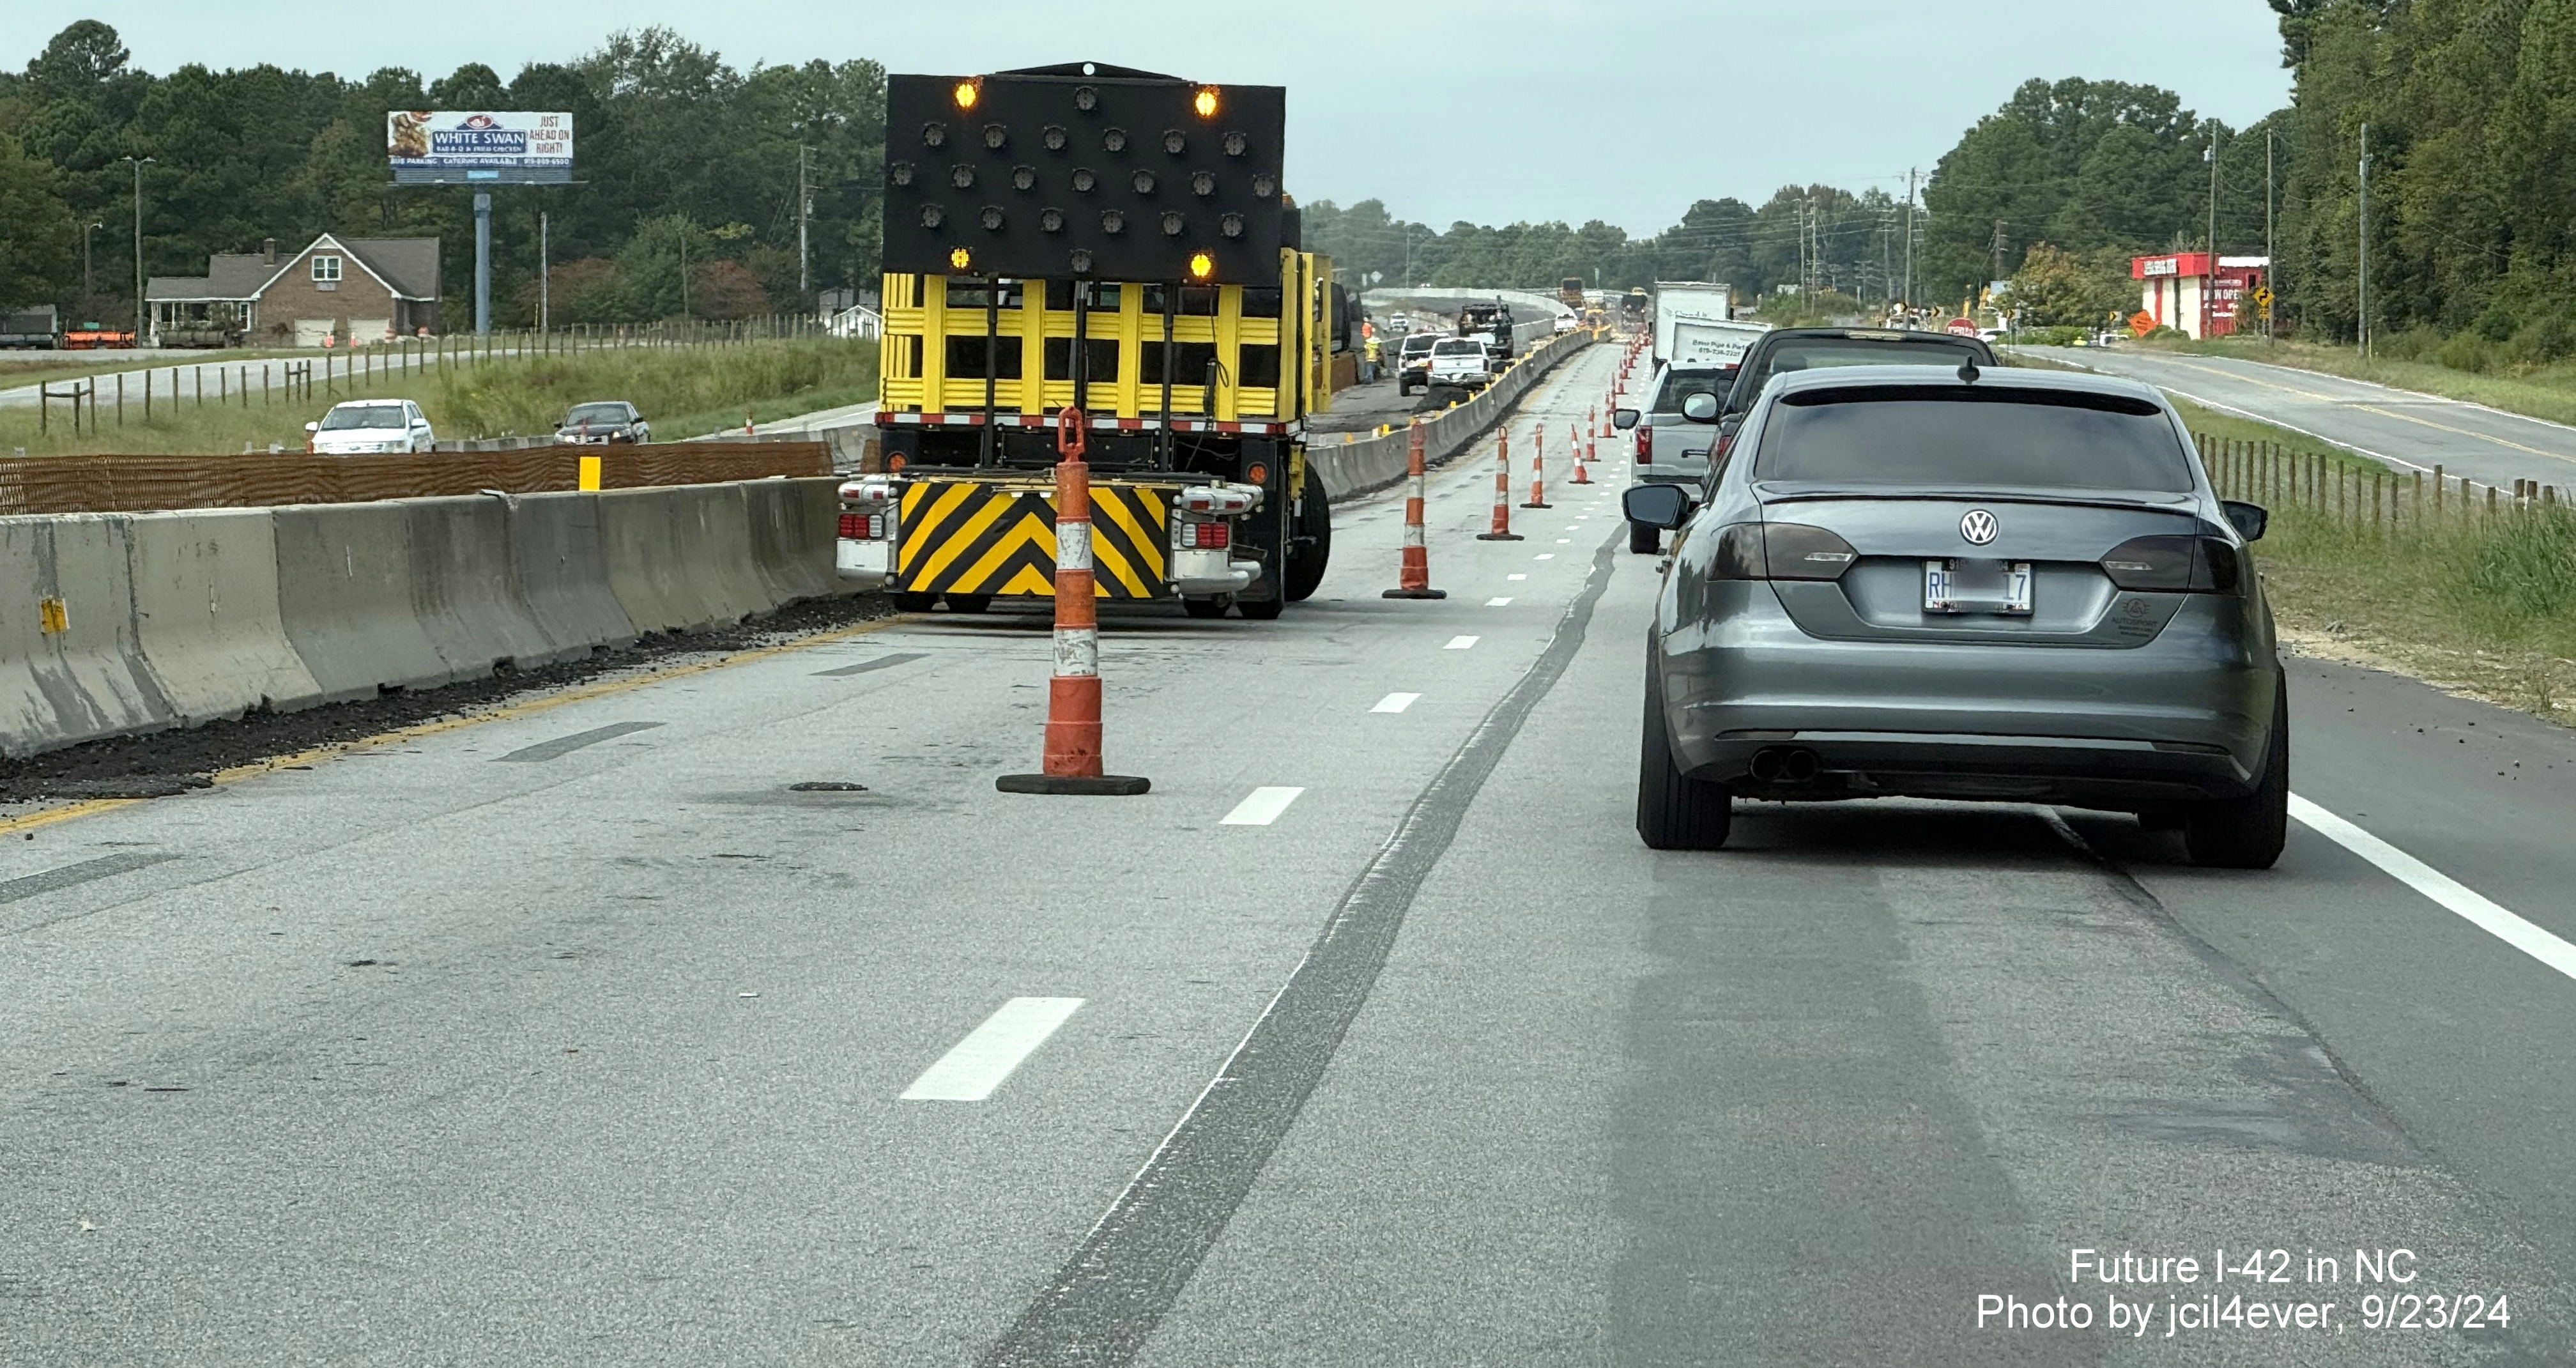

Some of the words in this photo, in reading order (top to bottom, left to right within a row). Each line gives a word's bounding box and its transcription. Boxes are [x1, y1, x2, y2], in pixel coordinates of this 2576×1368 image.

[540, 116, 559, 127] JUST
[435, 133, 478, 144] WHITE
[484, 133, 524, 144] SWAN
[530, 130, 556, 140] AHEAD
[558, 130, 569, 140] ON
[537, 142, 563, 153] RIGHT!
[2112, 617, 2158, 627] AUTOSPORT
